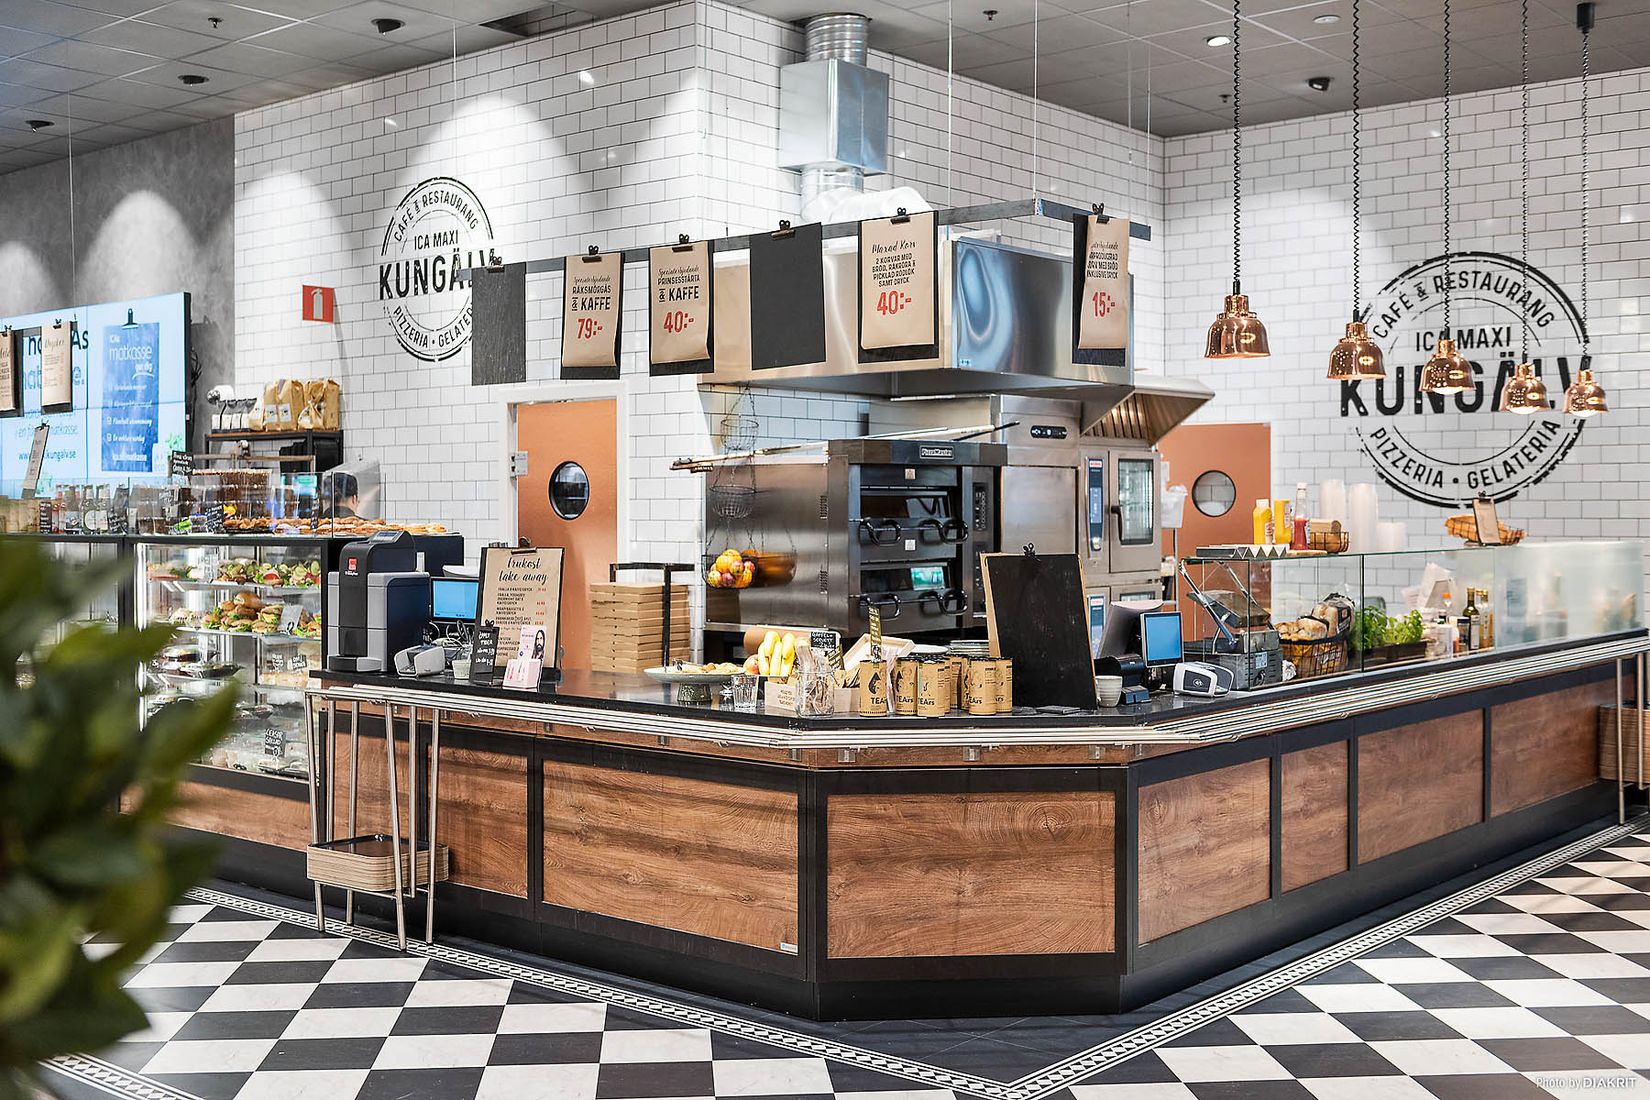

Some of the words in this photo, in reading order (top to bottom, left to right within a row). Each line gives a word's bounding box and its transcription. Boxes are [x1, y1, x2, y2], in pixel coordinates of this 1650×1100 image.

[422, 190, 479, 230] RESTAURANG
[414, 234, 430, 250] ICA
[433, 230, 459, 248] MAXI
[669, 285, 700, 302] KAFFE
[878, 279, 893, 288] SAMT
[581, 297, 611, 311] KAFFE
[876, 290, 912, 316] 40:-
[1092, 291, 1116, 317] 15:-
[1433, 270, 1555, 328] RESTAURANG
[393, 306, 428, 348] PIZZERIA
[577, 318, 603, 339] 79:-
[663, 310, 695, 334] 40:-
[1457, 326, 1511, 350] MAXI
[109, 345, 153, 361] matkasse
[1370, 427, 1444, 489] PIZZERIA
[1467, 419, 1561, 489] GELATERIA
[498, 570, 520, 582] take
[522, 573, 548, 585] away
